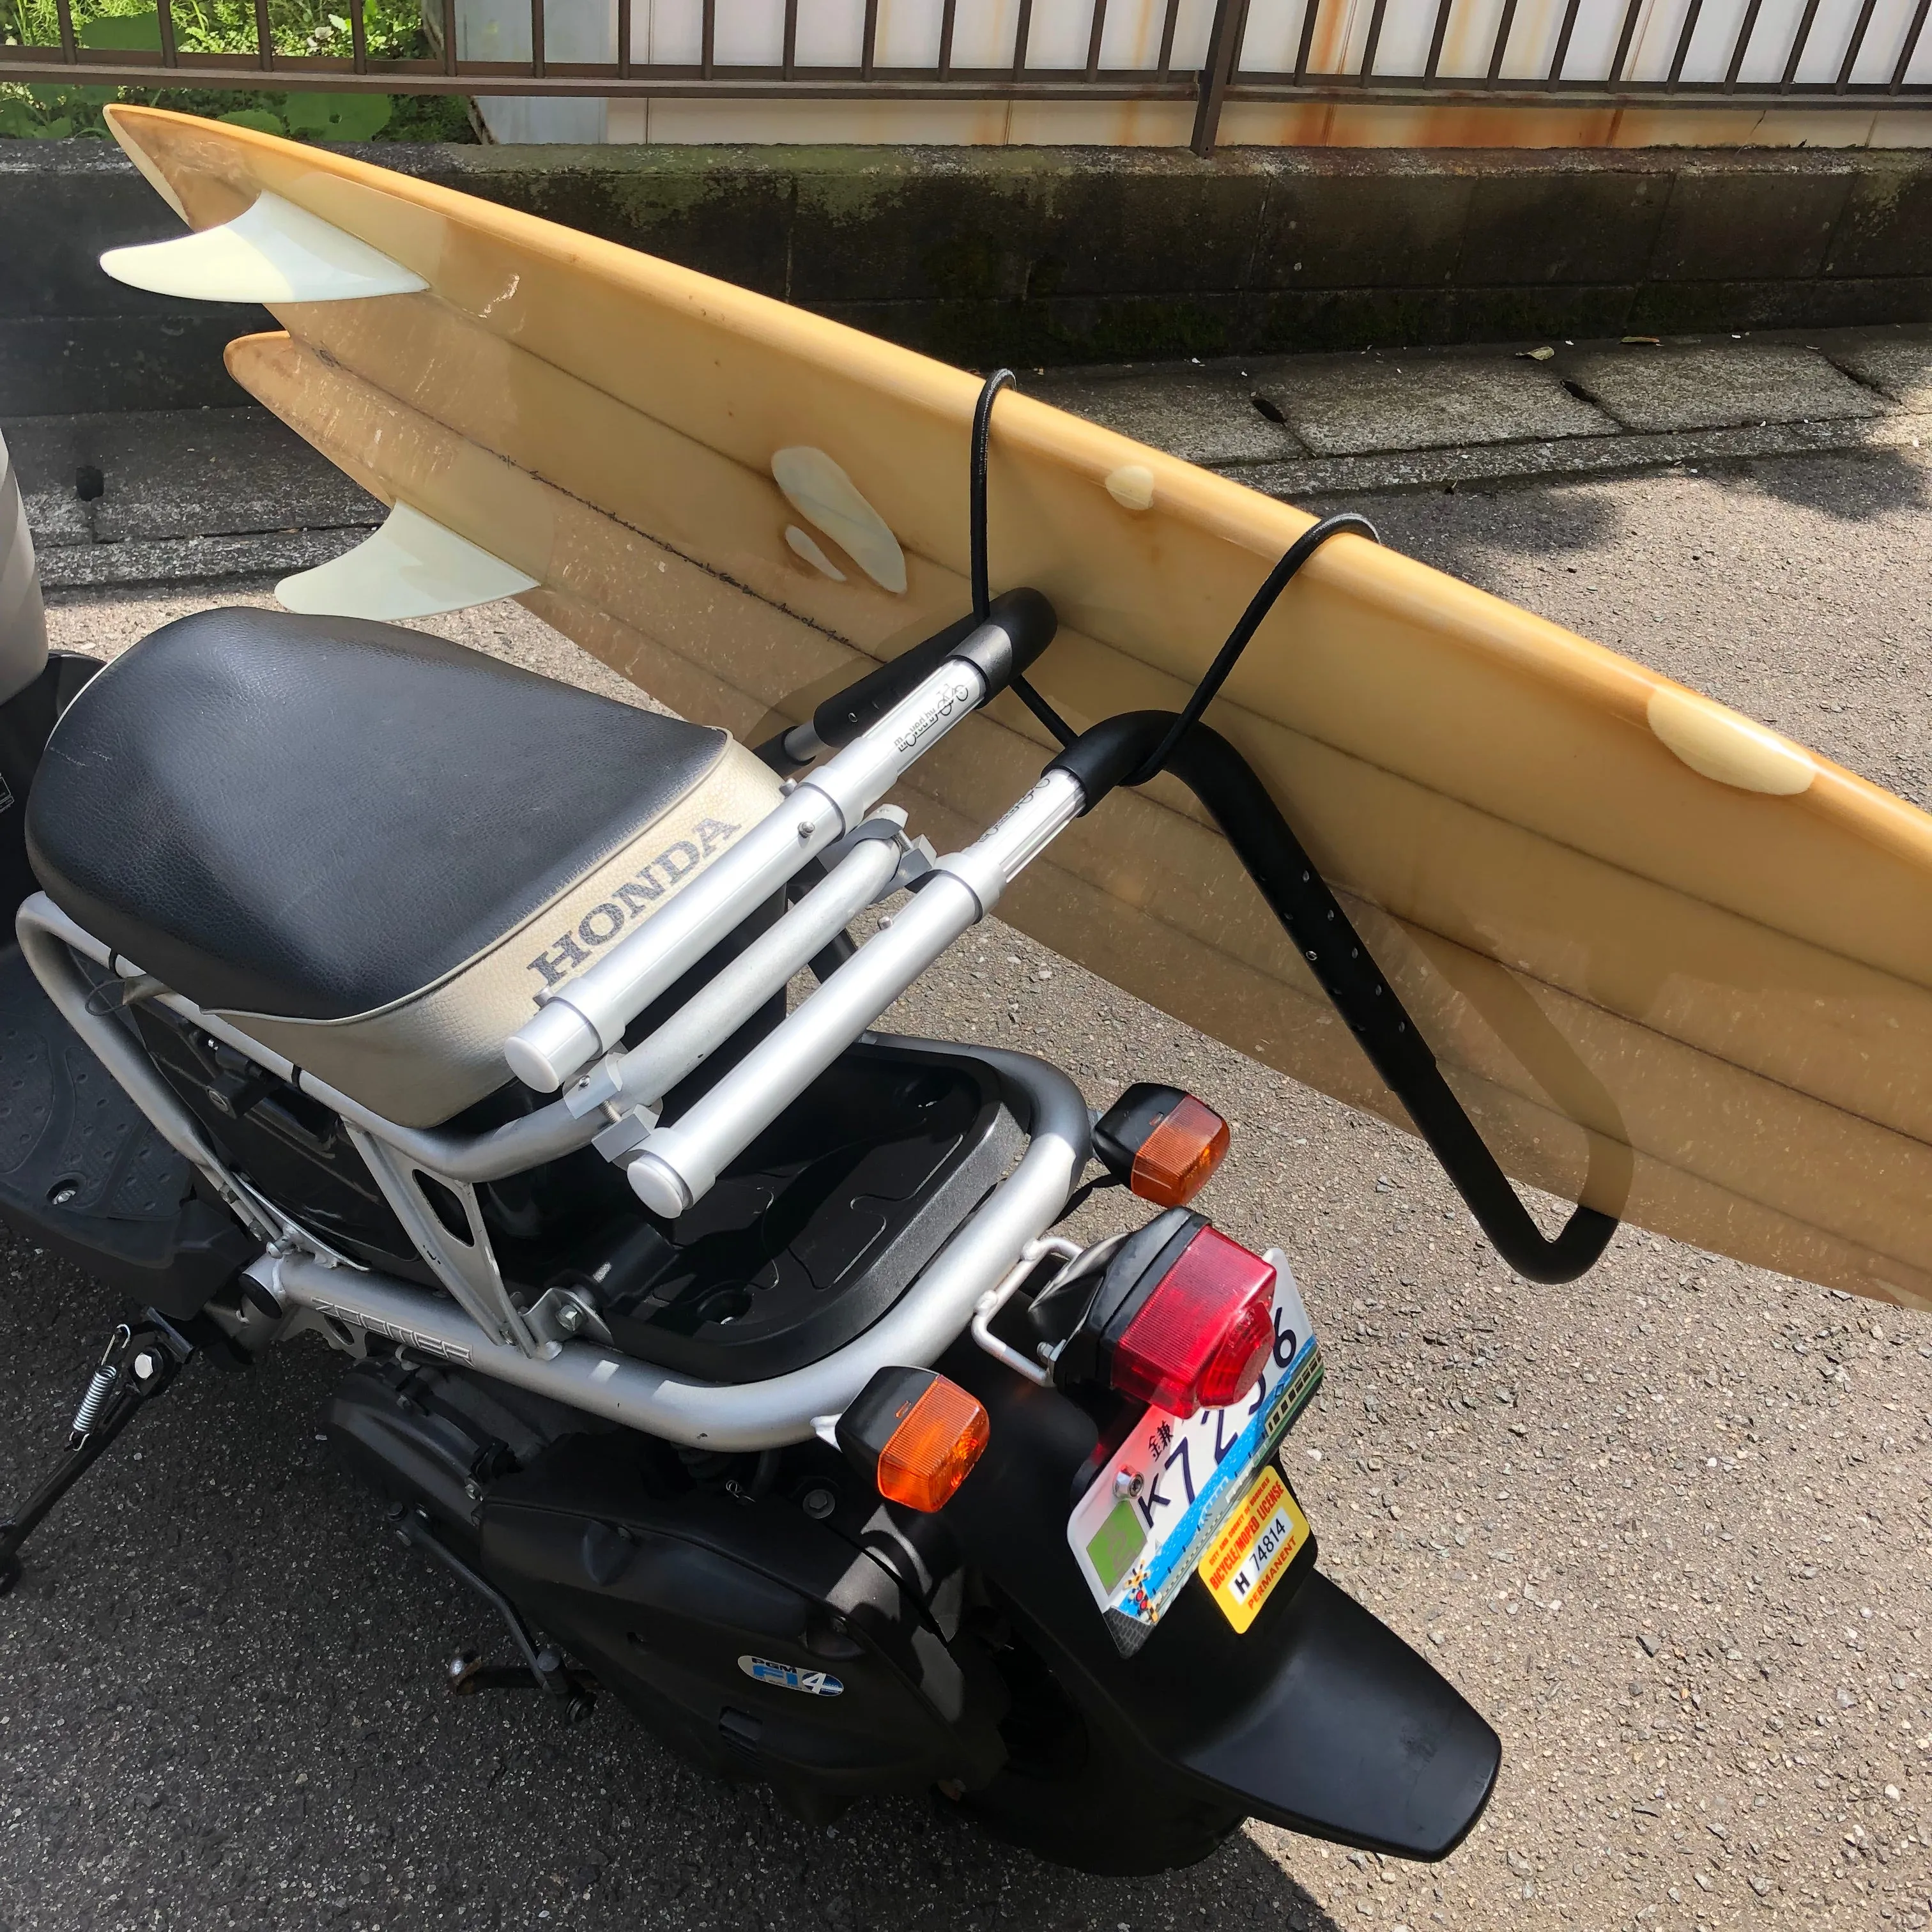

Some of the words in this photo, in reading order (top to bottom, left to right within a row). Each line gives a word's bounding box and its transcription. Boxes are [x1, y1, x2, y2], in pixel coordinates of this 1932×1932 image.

[526, 818, 742, 986] HONDA
[311, 1297, 475, 1368] ZOOMER
[1209, 1515, 1260, 1591] BICYCLE/MOPED
[1256, 1480, 1284, 1521] LICENSE
[1228, 1514, 1245, 1538] COUNTY
[1234, 1571, 1250, 1595] H
[1249, 1518, 1286, 1571] 74814
[1248, 1535, 1297, 1611] PERMANENT
